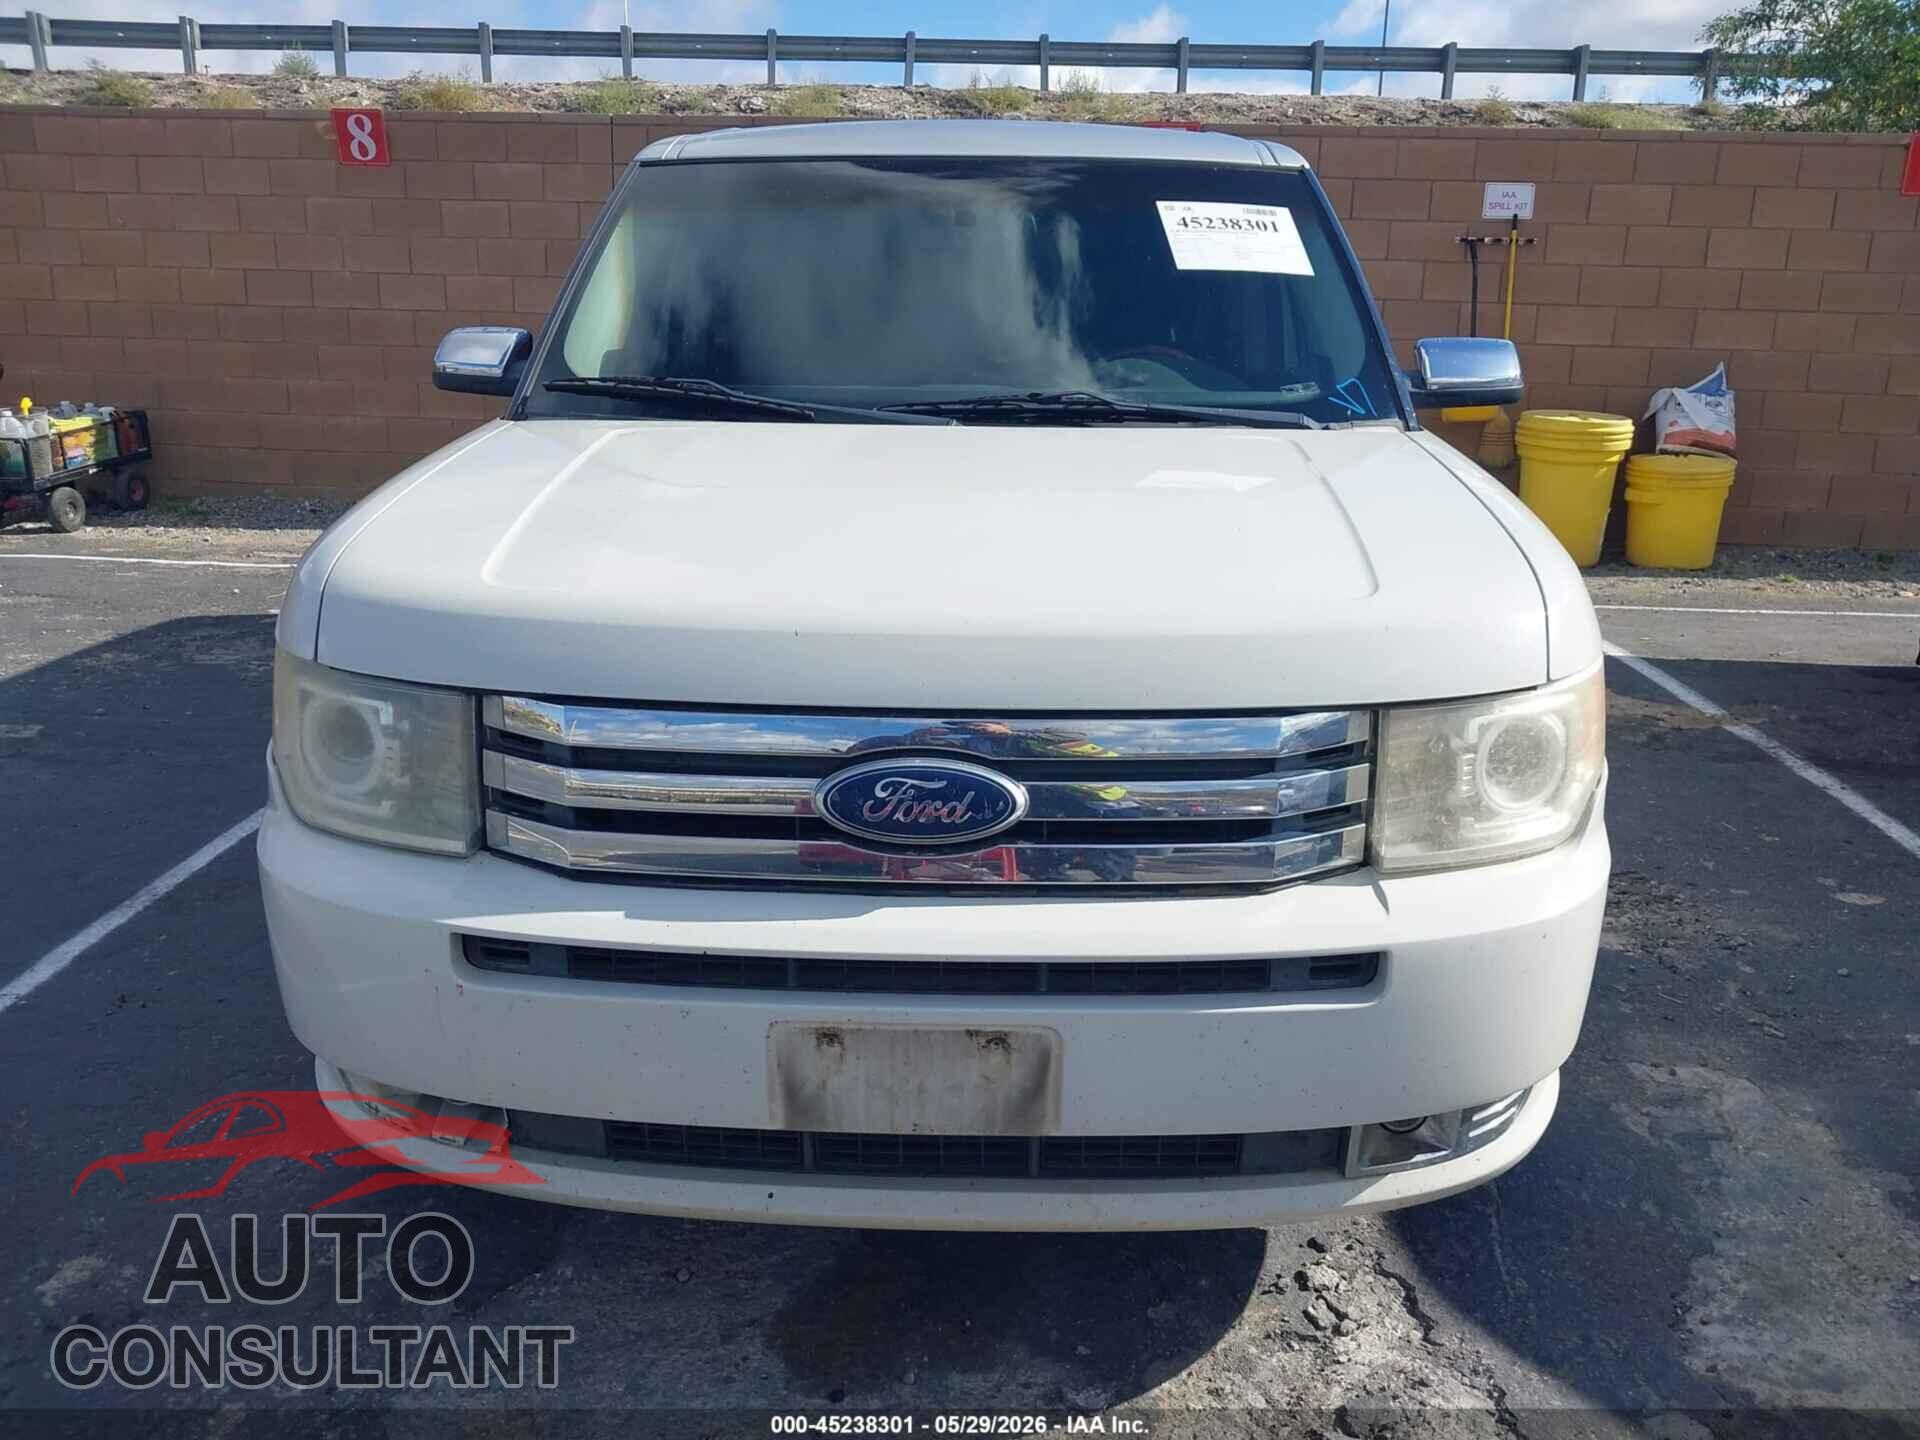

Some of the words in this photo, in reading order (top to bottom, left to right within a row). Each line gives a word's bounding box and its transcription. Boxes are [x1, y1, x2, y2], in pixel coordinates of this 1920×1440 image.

[347, 114, 376, 160] 8
[1488, 201, 1512, 210] SPILL
[1514, 202, 1528, 210] KIT
[1176, 216, 1279, 233] 45238301
[863, 777, 975, 823] Ford
